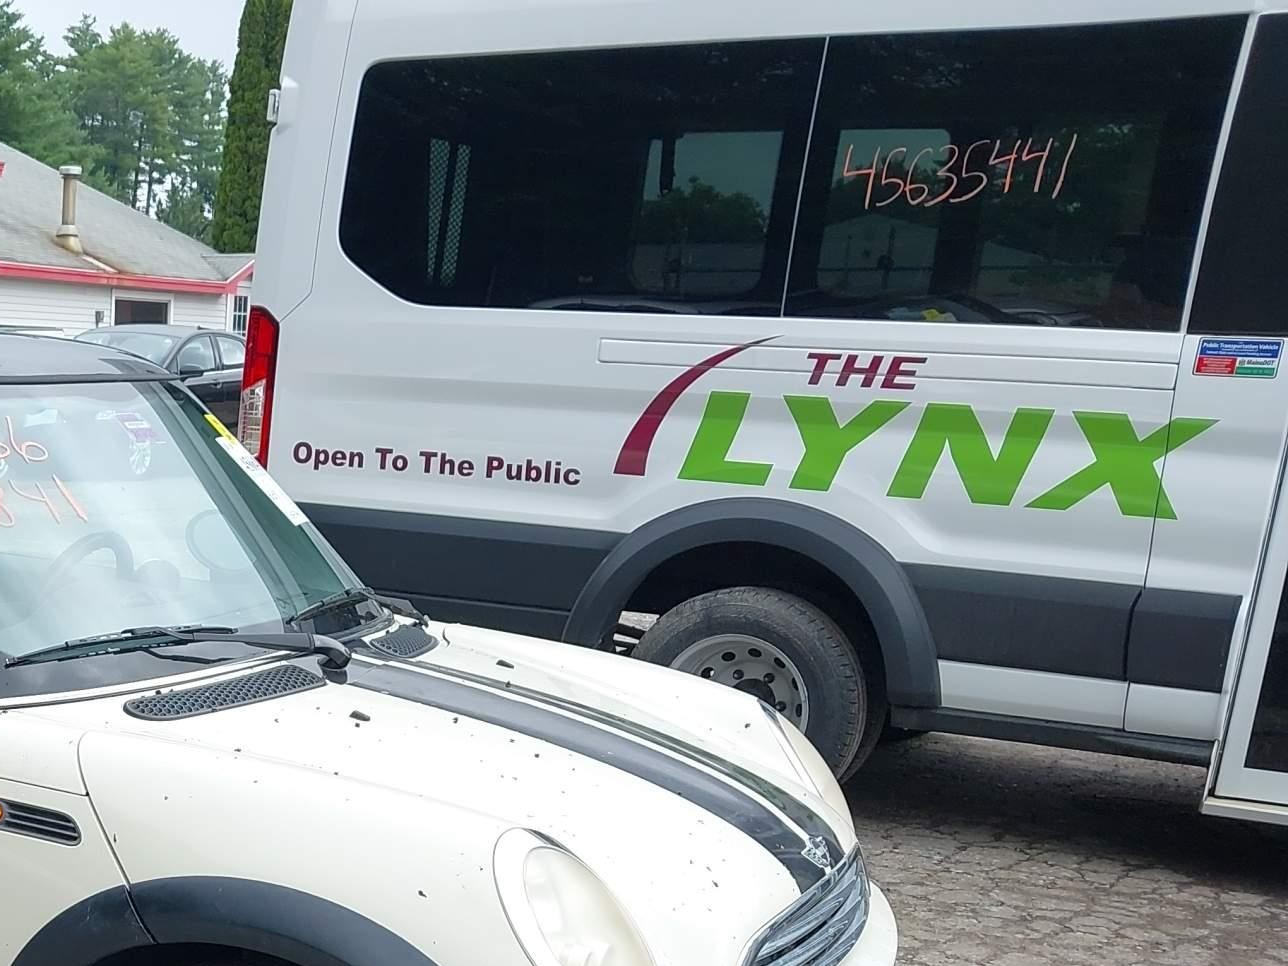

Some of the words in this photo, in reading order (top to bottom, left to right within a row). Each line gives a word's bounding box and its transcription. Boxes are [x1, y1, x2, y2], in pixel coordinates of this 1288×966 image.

[843, 133, 1078, 210] 45635441
[806, 352, 929, 390] THE
[292, 441, 364, 471] Open
[374, 447, 409, 472] To
[419, 451, 475, 477] The
[485, 456, 582, 486] Public
[676, 390, 1222, 521] LYNX
